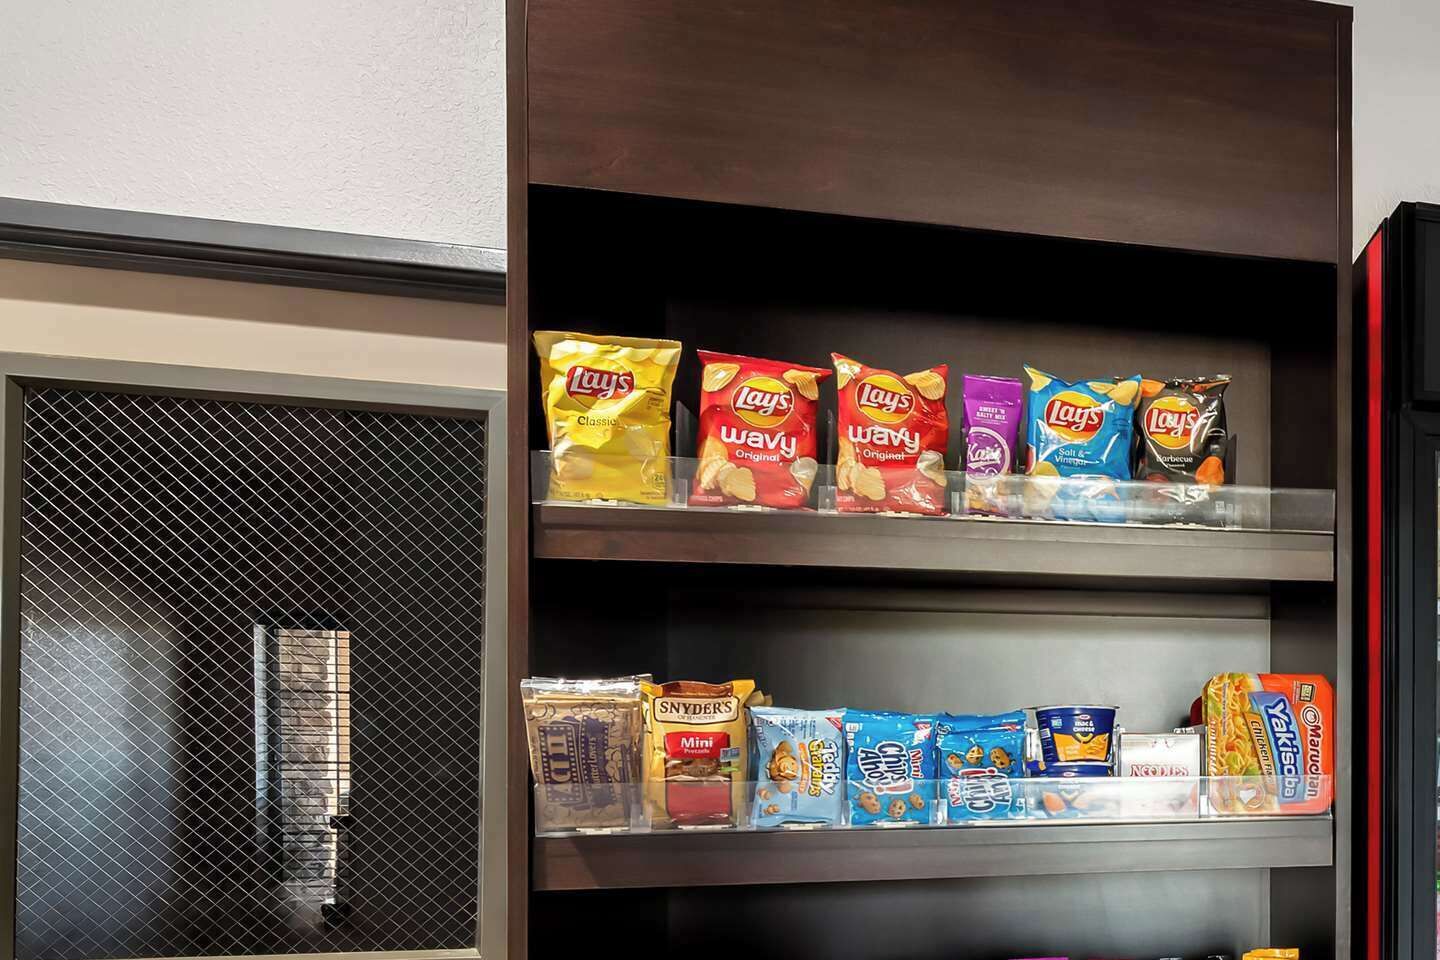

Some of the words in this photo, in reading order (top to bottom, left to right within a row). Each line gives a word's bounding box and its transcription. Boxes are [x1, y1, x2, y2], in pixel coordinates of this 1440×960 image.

[567, 366, 634, 400] Lay's
[736, 386, 792, 414] Lay's
[859, 384, 913, 413] Lay's
[577, 414, 617, 428] Classic
[976, 411, 994, 419] SALTY
[1050, 400, 1099, 431] Lay's
[1150, 408, 1197, 437] Lay's
[720, 424, 798, 458] wavy
[848, 422, 921, 455] wavy
[1058, 447, 1077, 458] Salt
[1077, 448, 1087, 458] &
[735, 448, 781, 465] Original
[862, 449, 906, 463] Original
[1054, 455, 1088, 466] Vinegar
[1156, 454, 1194, 464] Barbecue
[659, 701, 733, 715] SNYDER'S
[587, 736, 599, 764] Lovers
[681, 736, 713, 748] Mini
[1250, 720, 1271, 762] Chicken
[1266, 701, 1300, 798] Yakisoba
[808, 739, 825, 797] Grahams
[822, 739, 841, 795] Teddy
[875, 743, 910, 784] Chips
[907, 749, 924, 779] Mini
[1305, 725, 1322, 797] Maruchan
[549, 758, 574, 796] ACT
